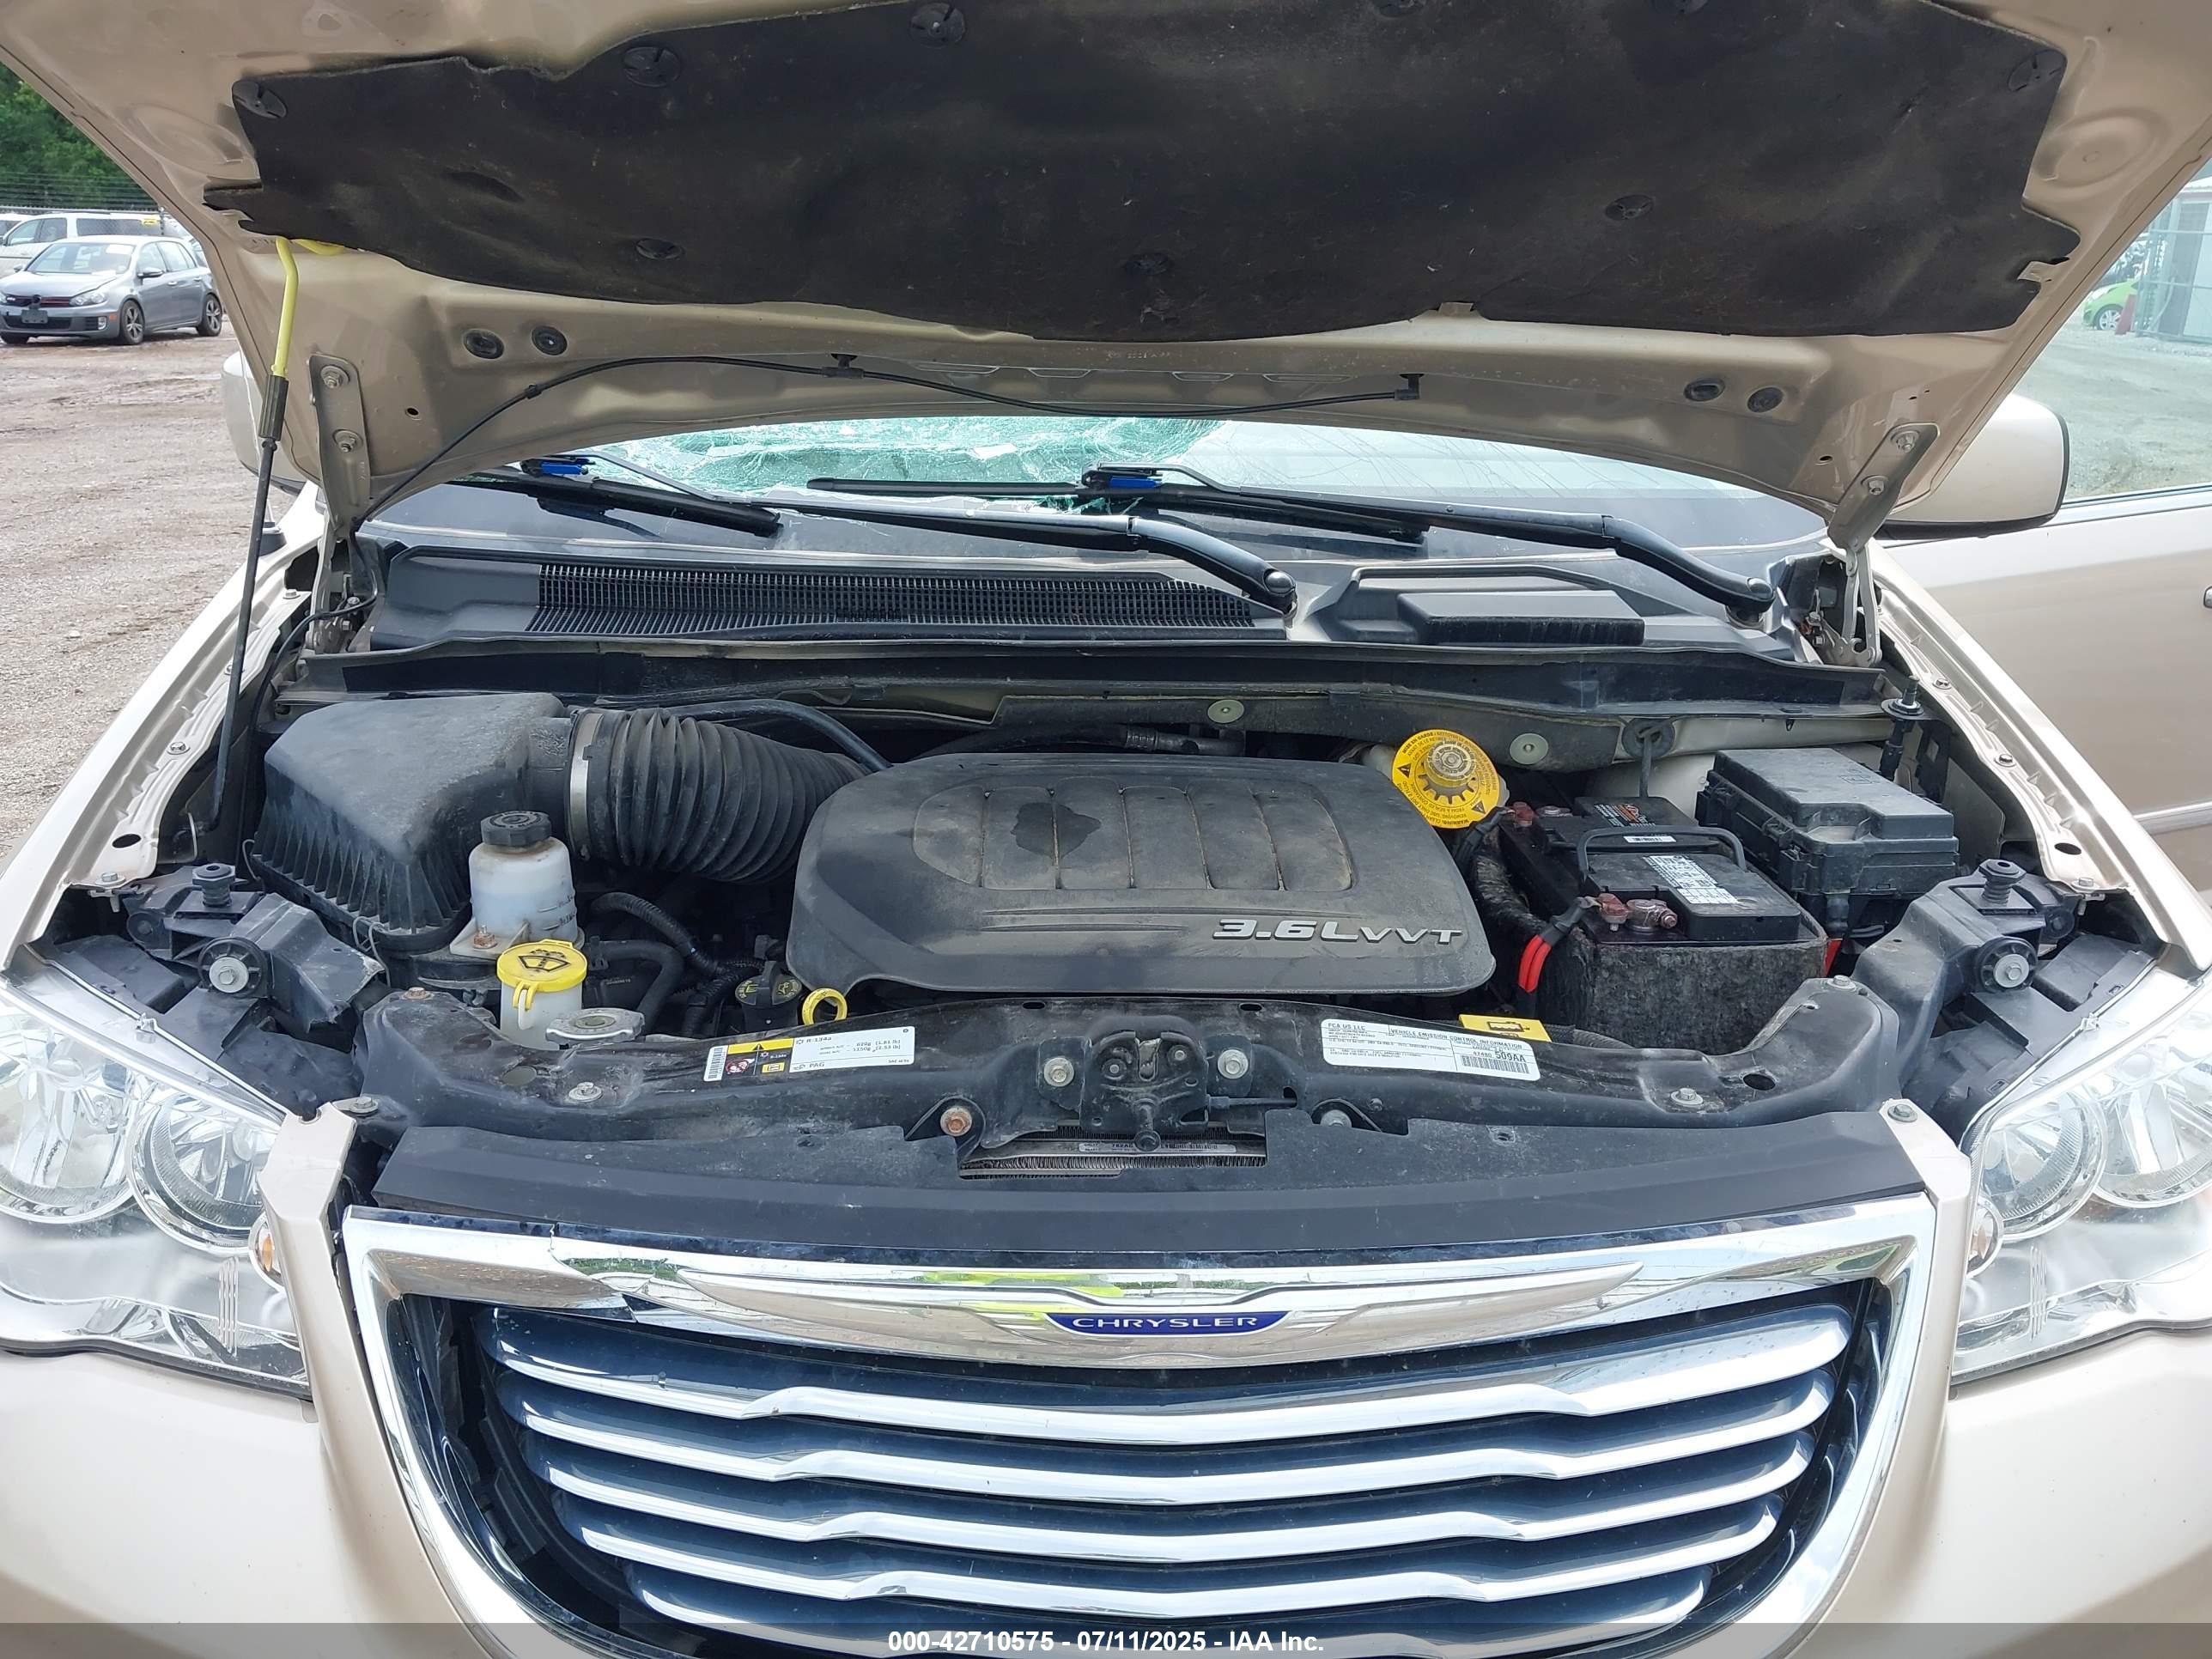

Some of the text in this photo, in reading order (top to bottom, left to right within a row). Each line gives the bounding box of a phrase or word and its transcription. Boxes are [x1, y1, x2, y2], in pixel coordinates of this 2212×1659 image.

[1480, 1039, 1522, 1049] INFORMATION
[1495, 1051, 1527, 1062] 509AA
[1073, 1317, 1257, 1328] CHRYSLER
